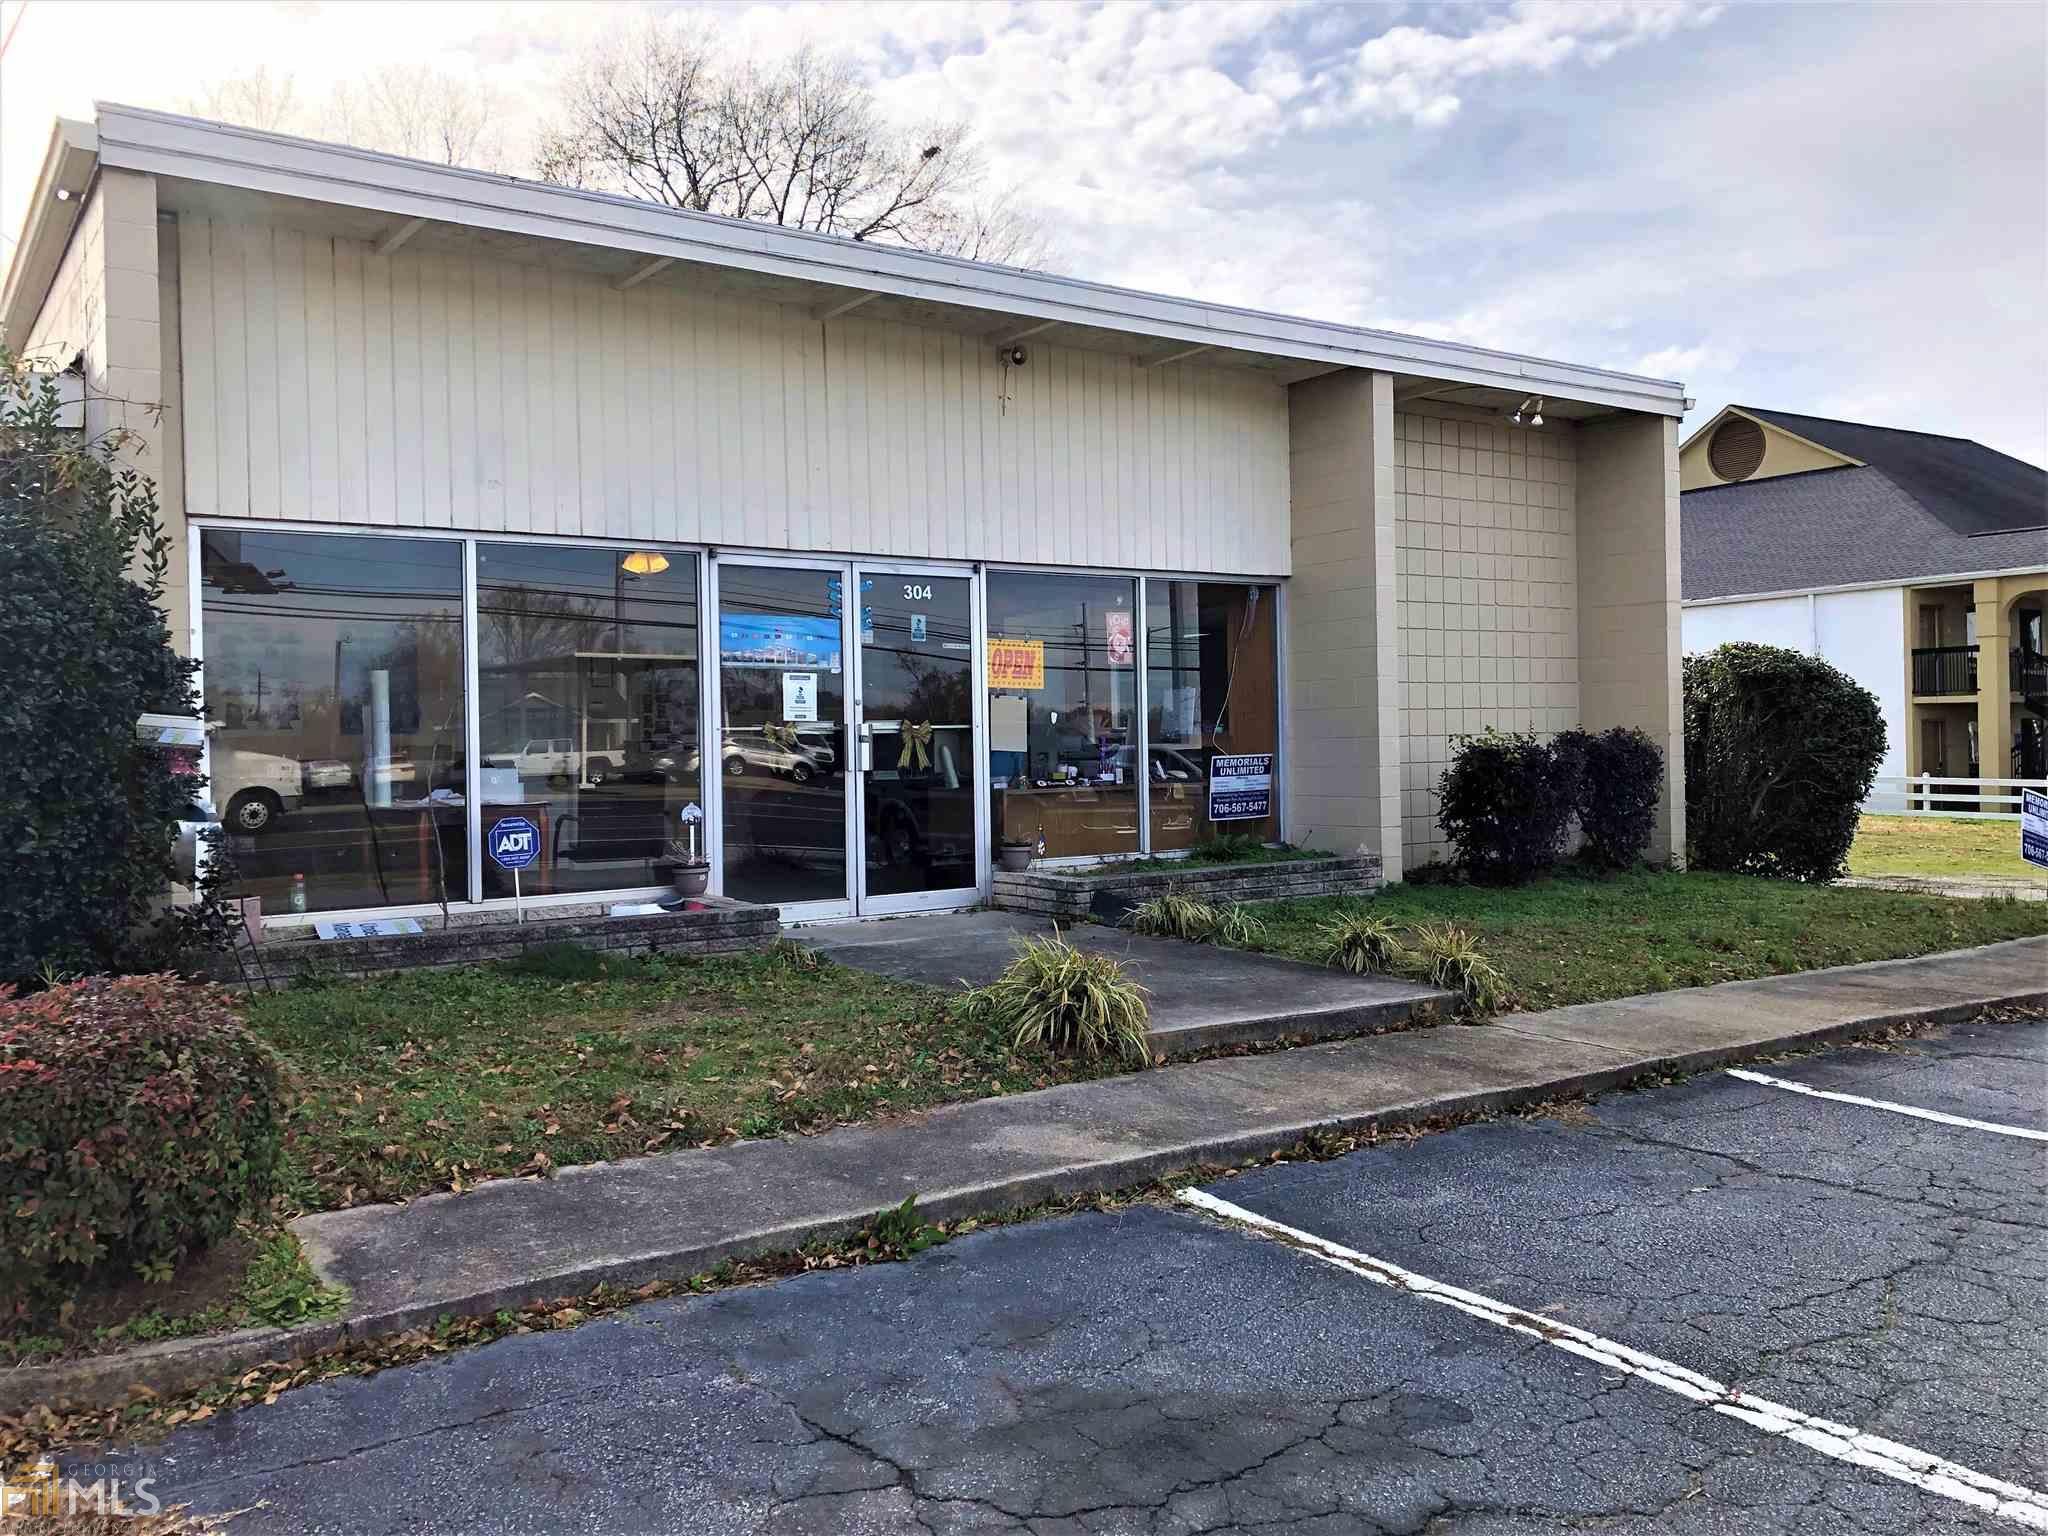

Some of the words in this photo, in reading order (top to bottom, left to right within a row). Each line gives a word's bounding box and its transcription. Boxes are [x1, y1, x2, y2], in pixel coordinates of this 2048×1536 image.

[903, 584, 932, 600] 304
[991, 647, 1036, 679] OPEN
[1216, 757, 1269, 768] MEMORIALS
[1220, 766, 1264, 776] UNLIMITED
[1213, 801, 1267, 814] 706-567-5477
[498, 833, 531, 852] ADT
